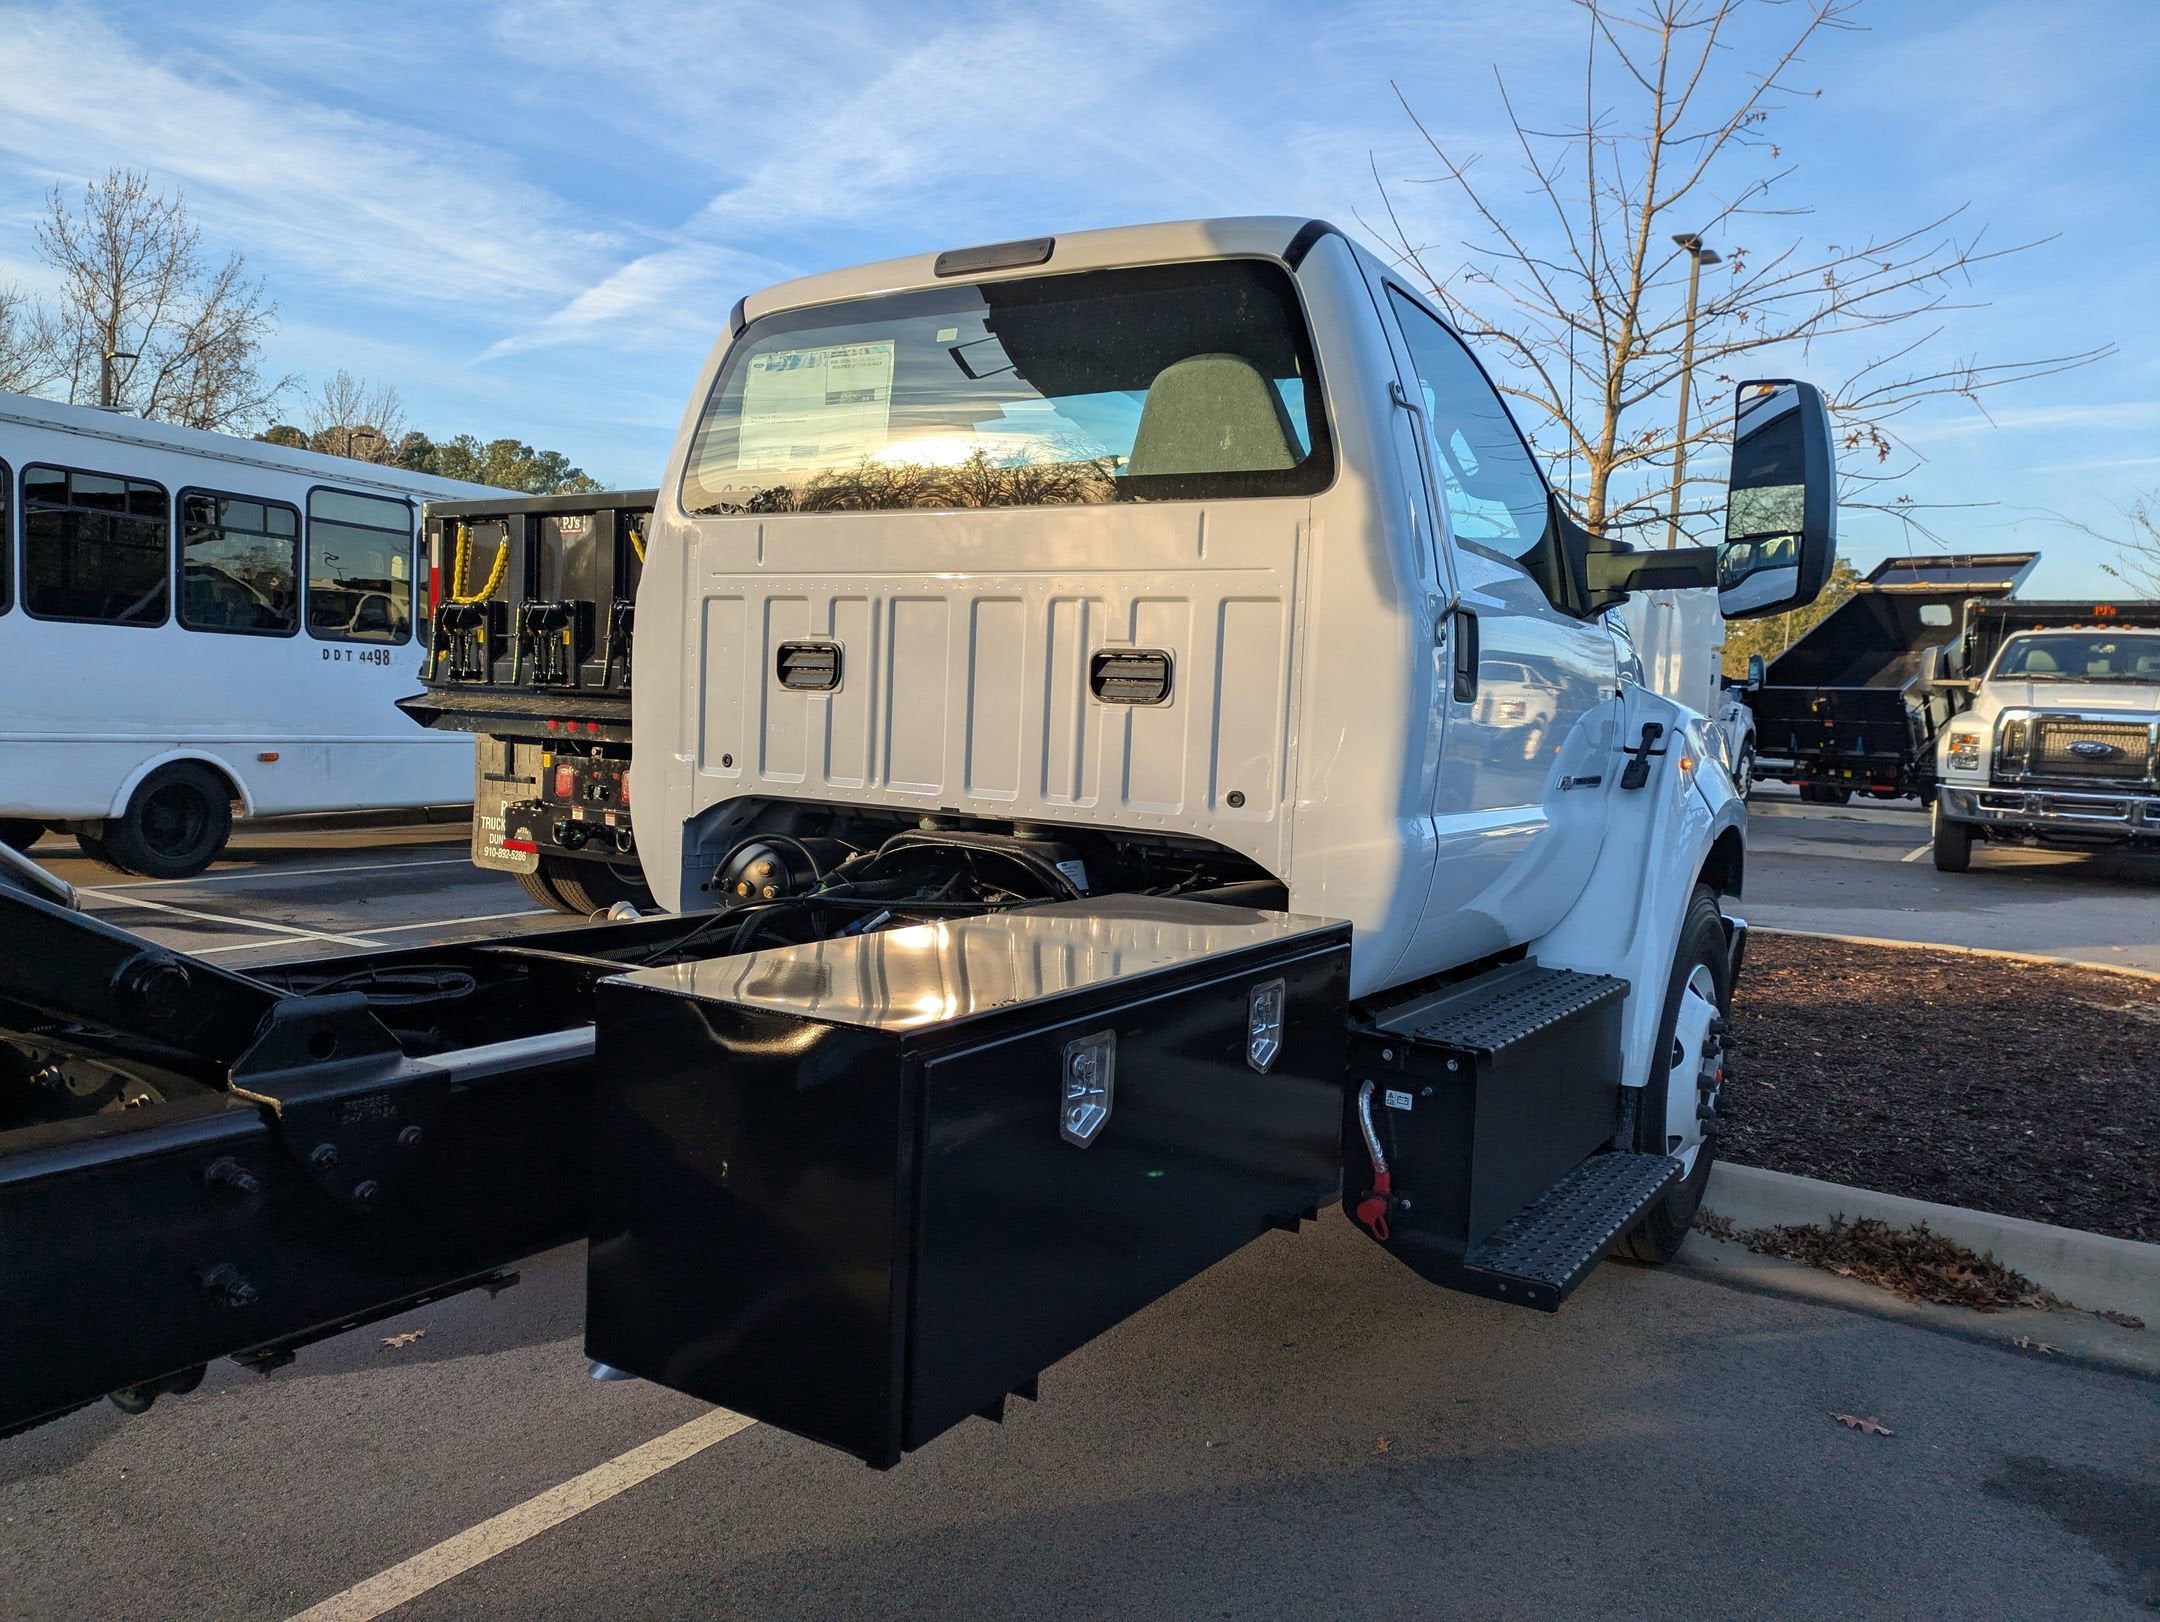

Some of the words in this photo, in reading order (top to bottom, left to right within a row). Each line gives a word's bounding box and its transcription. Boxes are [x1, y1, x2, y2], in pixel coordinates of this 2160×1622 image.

[562, 516, 580, 529] PJ's
[360, 649, 390, 666] 4498
[484, 846, 527, 861] 910-892-5286
